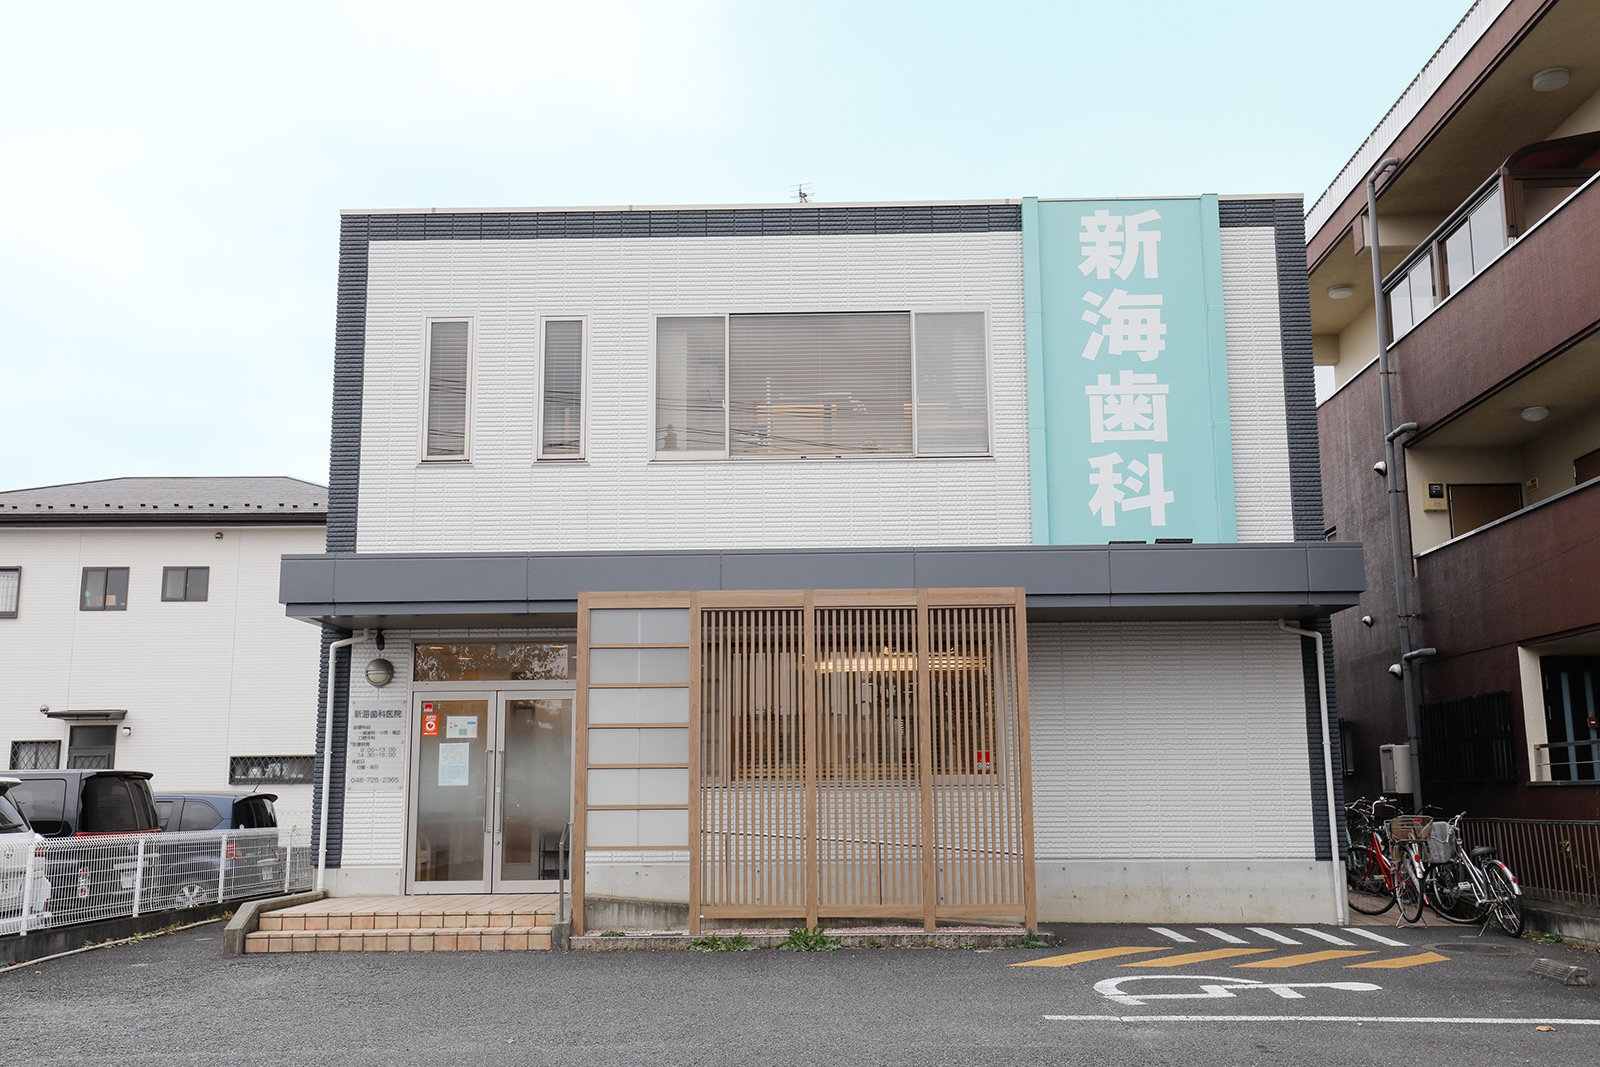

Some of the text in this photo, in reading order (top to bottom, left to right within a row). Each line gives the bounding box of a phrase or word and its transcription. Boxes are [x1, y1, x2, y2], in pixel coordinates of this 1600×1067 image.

[1078, 208, 1174, 526] 新海歯科
[354, 709, 402, 718] 新海歯科医院
